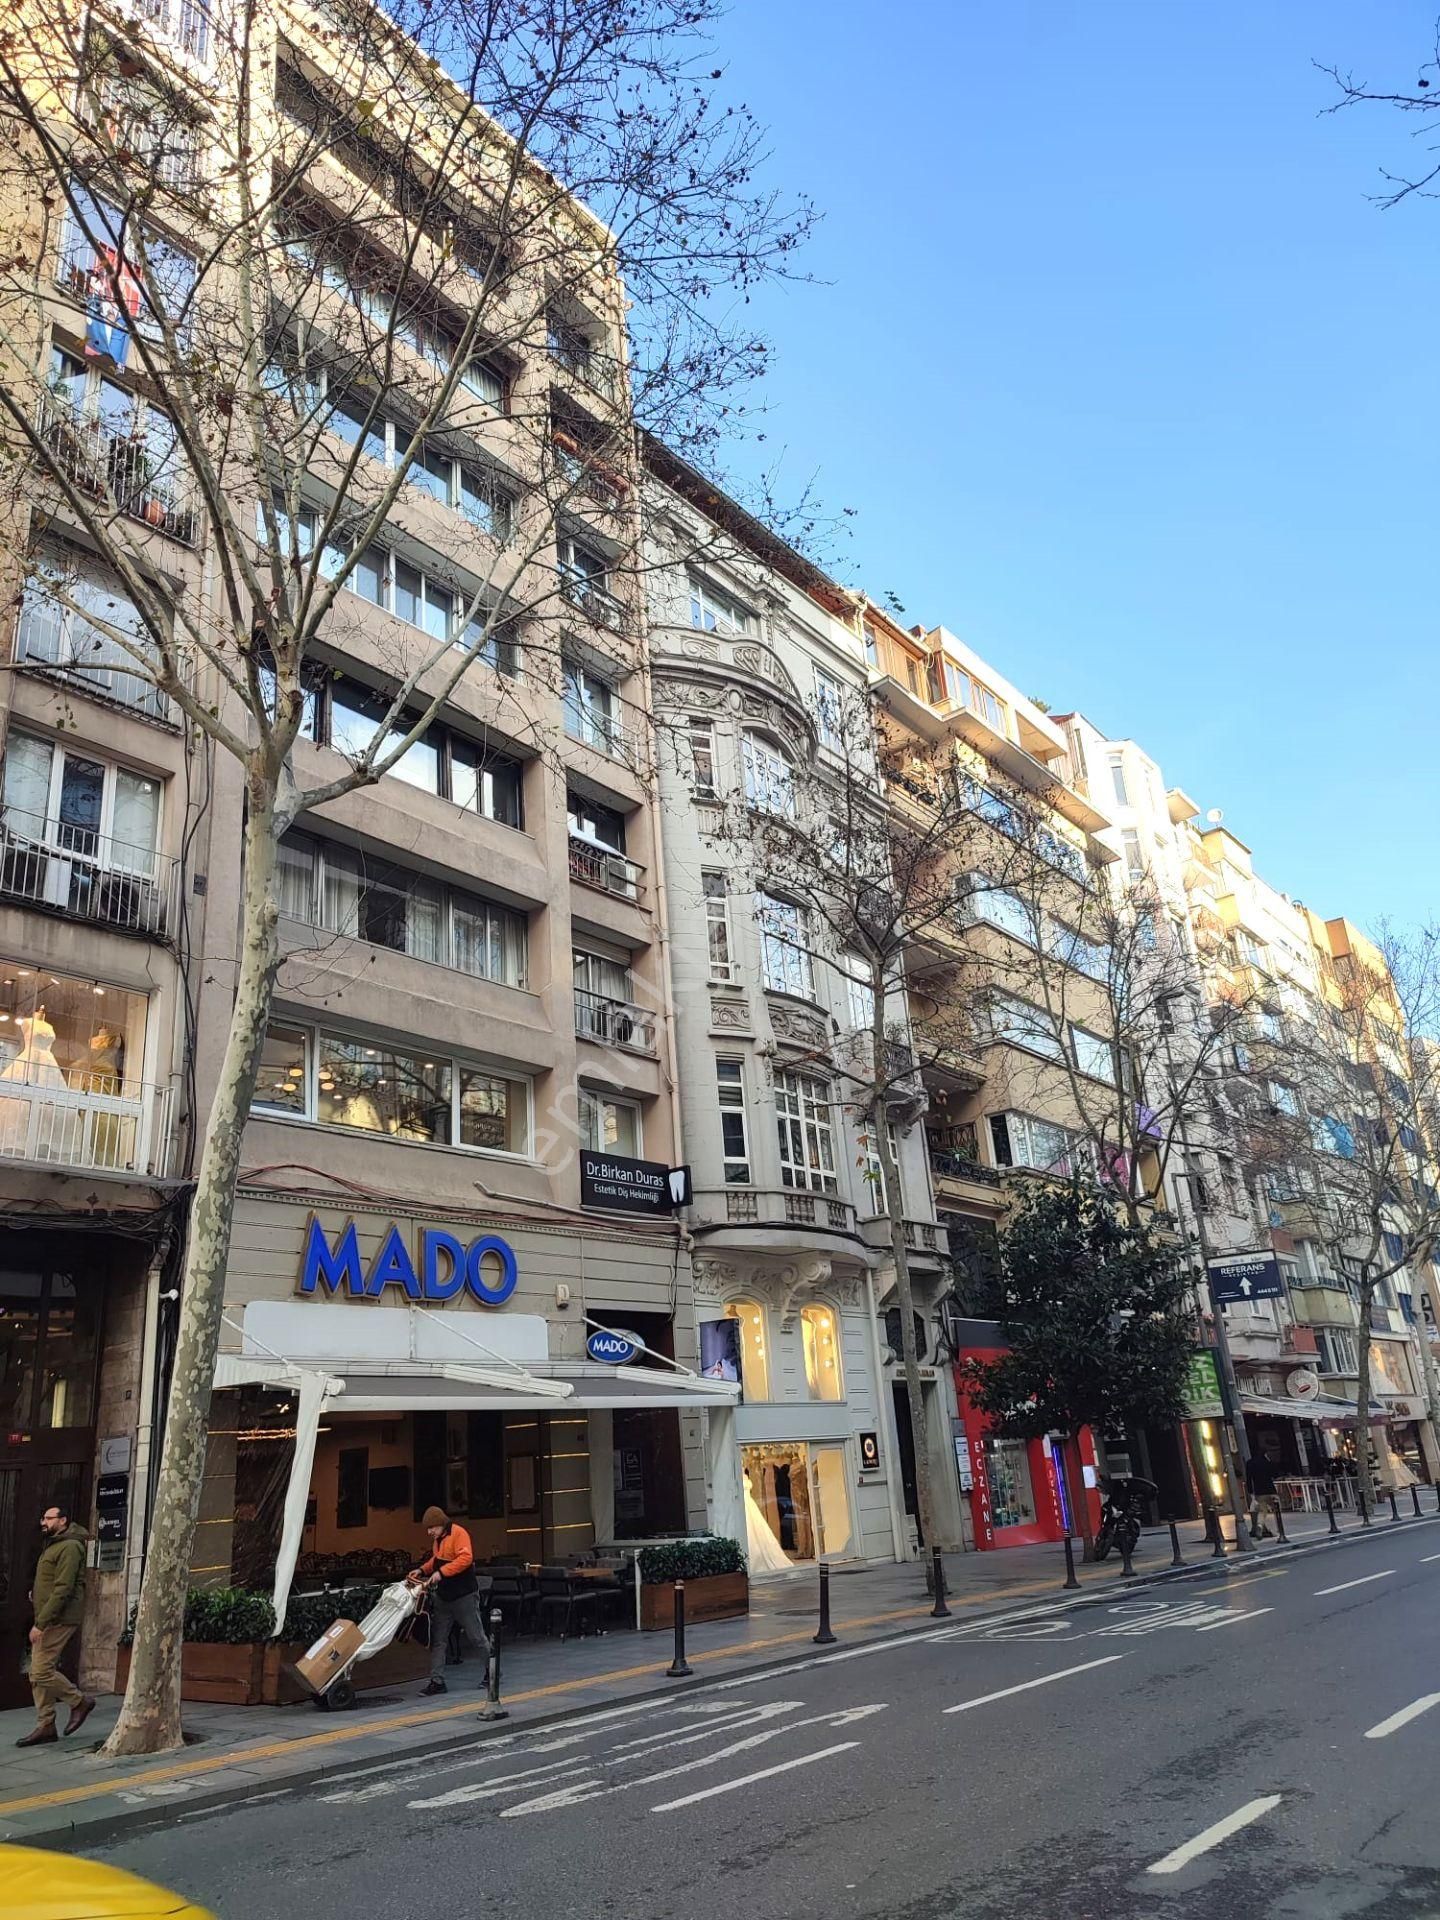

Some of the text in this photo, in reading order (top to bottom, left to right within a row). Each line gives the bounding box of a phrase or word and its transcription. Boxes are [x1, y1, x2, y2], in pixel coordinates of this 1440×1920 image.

[586, 1161, 664, 1187] Dr.Birkan Duras
[594, 1183, 617, 1195] Estetik
[618, 1187, 629, 1199] Diş
[296, 1210, 518, 1307] MADO
[1220, 1263, 1265, 1275] REFERANS
[593, 1338, 629, 1354] MADO
[974, 1442, 992, 1540] ECZANE
